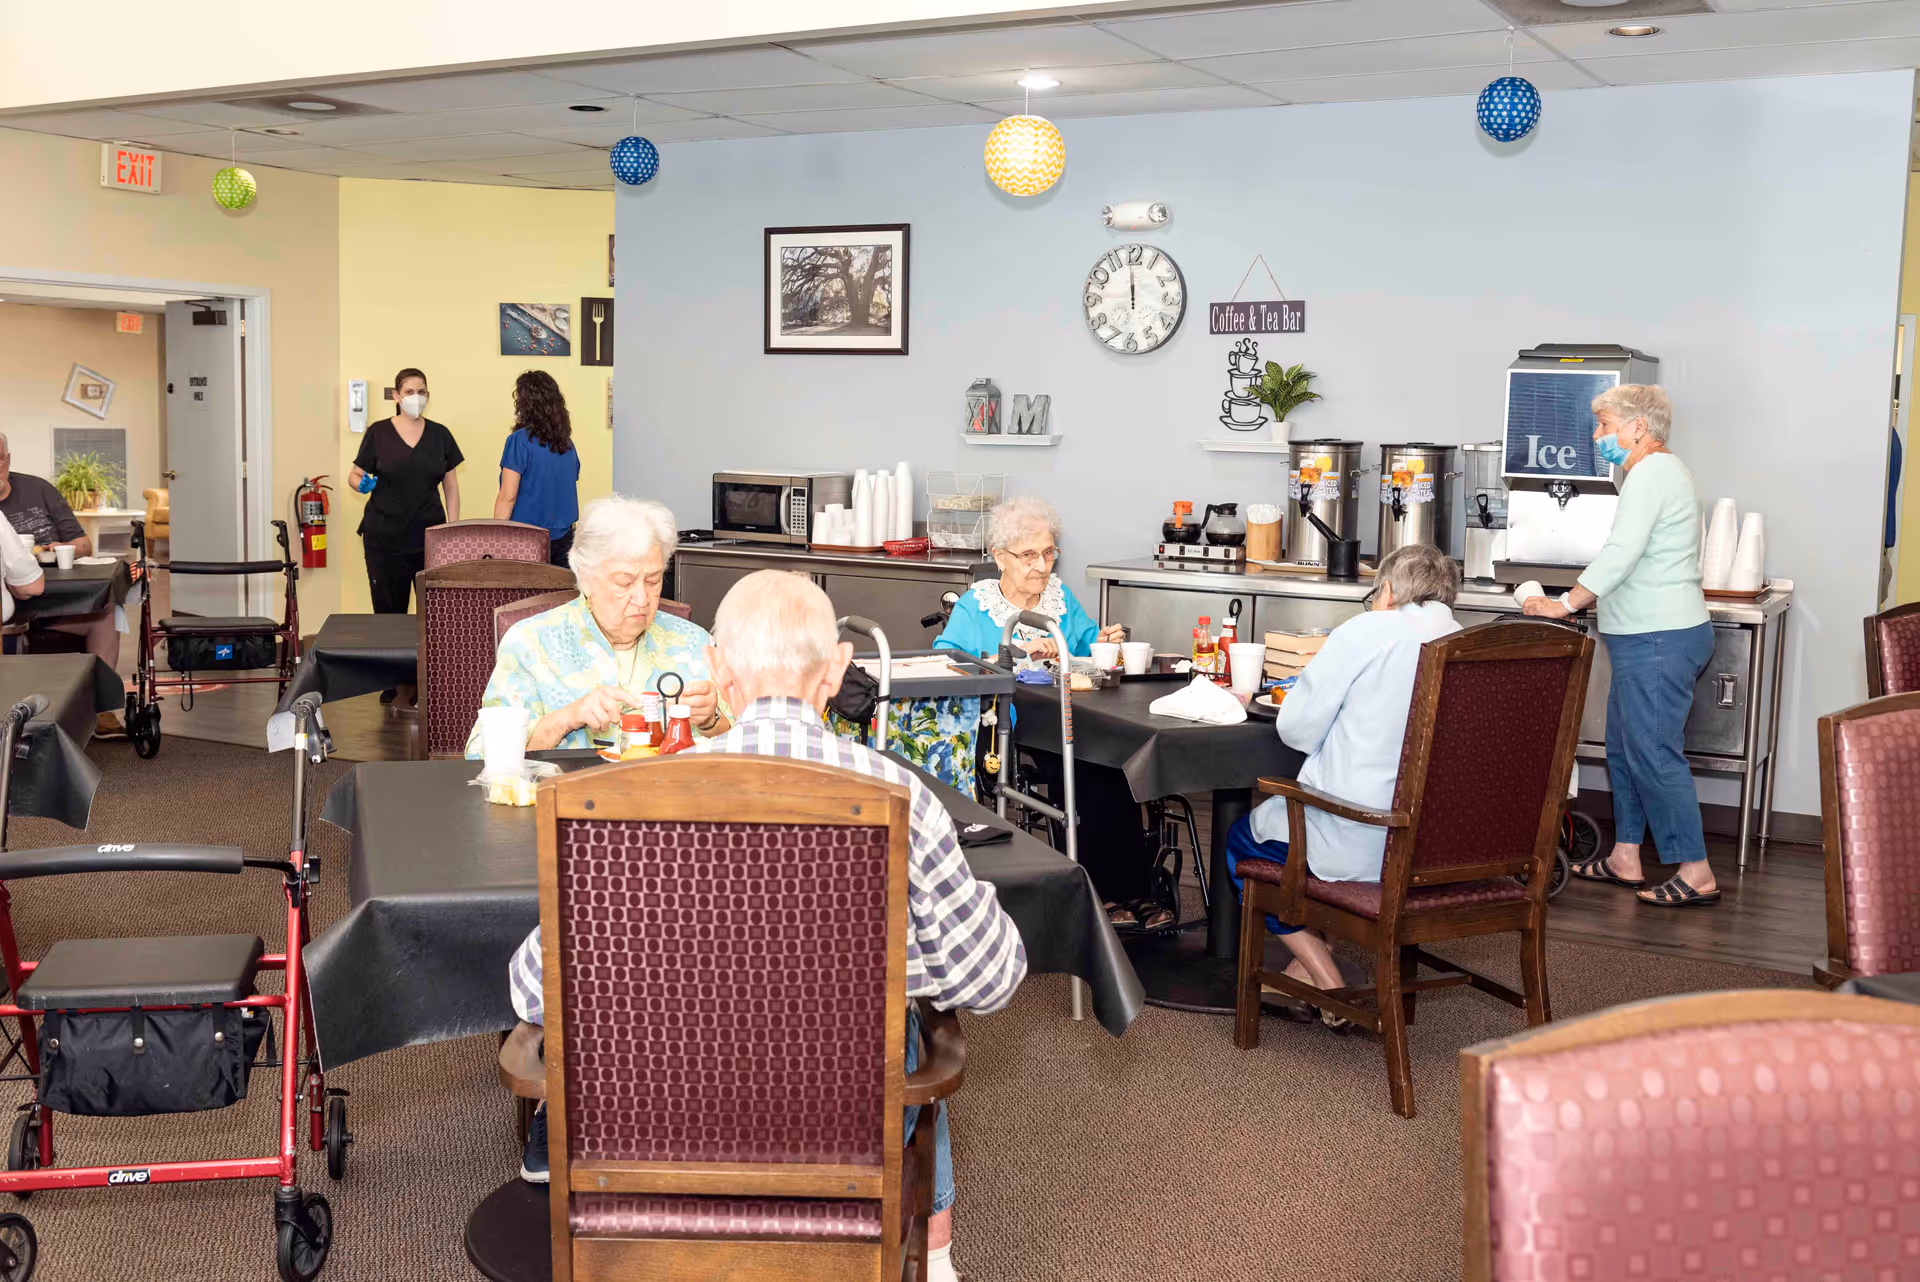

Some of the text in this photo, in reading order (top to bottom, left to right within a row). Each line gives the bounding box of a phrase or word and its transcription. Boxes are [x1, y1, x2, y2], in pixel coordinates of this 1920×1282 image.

[117, 150, 155, 187] EXIT
[1107, 249, 1123, 273] 11
[1126, 244, 1143, 265] 12
[1146, 250, 1160, 270] 1
[1089, 266, 1110, 290] 10
[1156, 267, 1177, 288] 2
[1083, 292, 1102, 308] 9
[1162, 291, 1181, 306] 3
[1089, 312, 1107, 331] 8
[1159, 311, 1176, 331] 4
[1212, 304, 1301, 332] Coffee & Tea Bar
[1103, 325, 1122, 343] 7
[1124, 332, 1138, 352] 6
[1143, 325, 1158, 347] 5
[1007, 394, 1051, 435] M
[1524, 435, 1577, 469] Ice
[1553, 484, 1569, 492] ICE
[97, 844, 136, 853] drive
[109, 1170, 148, 1183] drive
